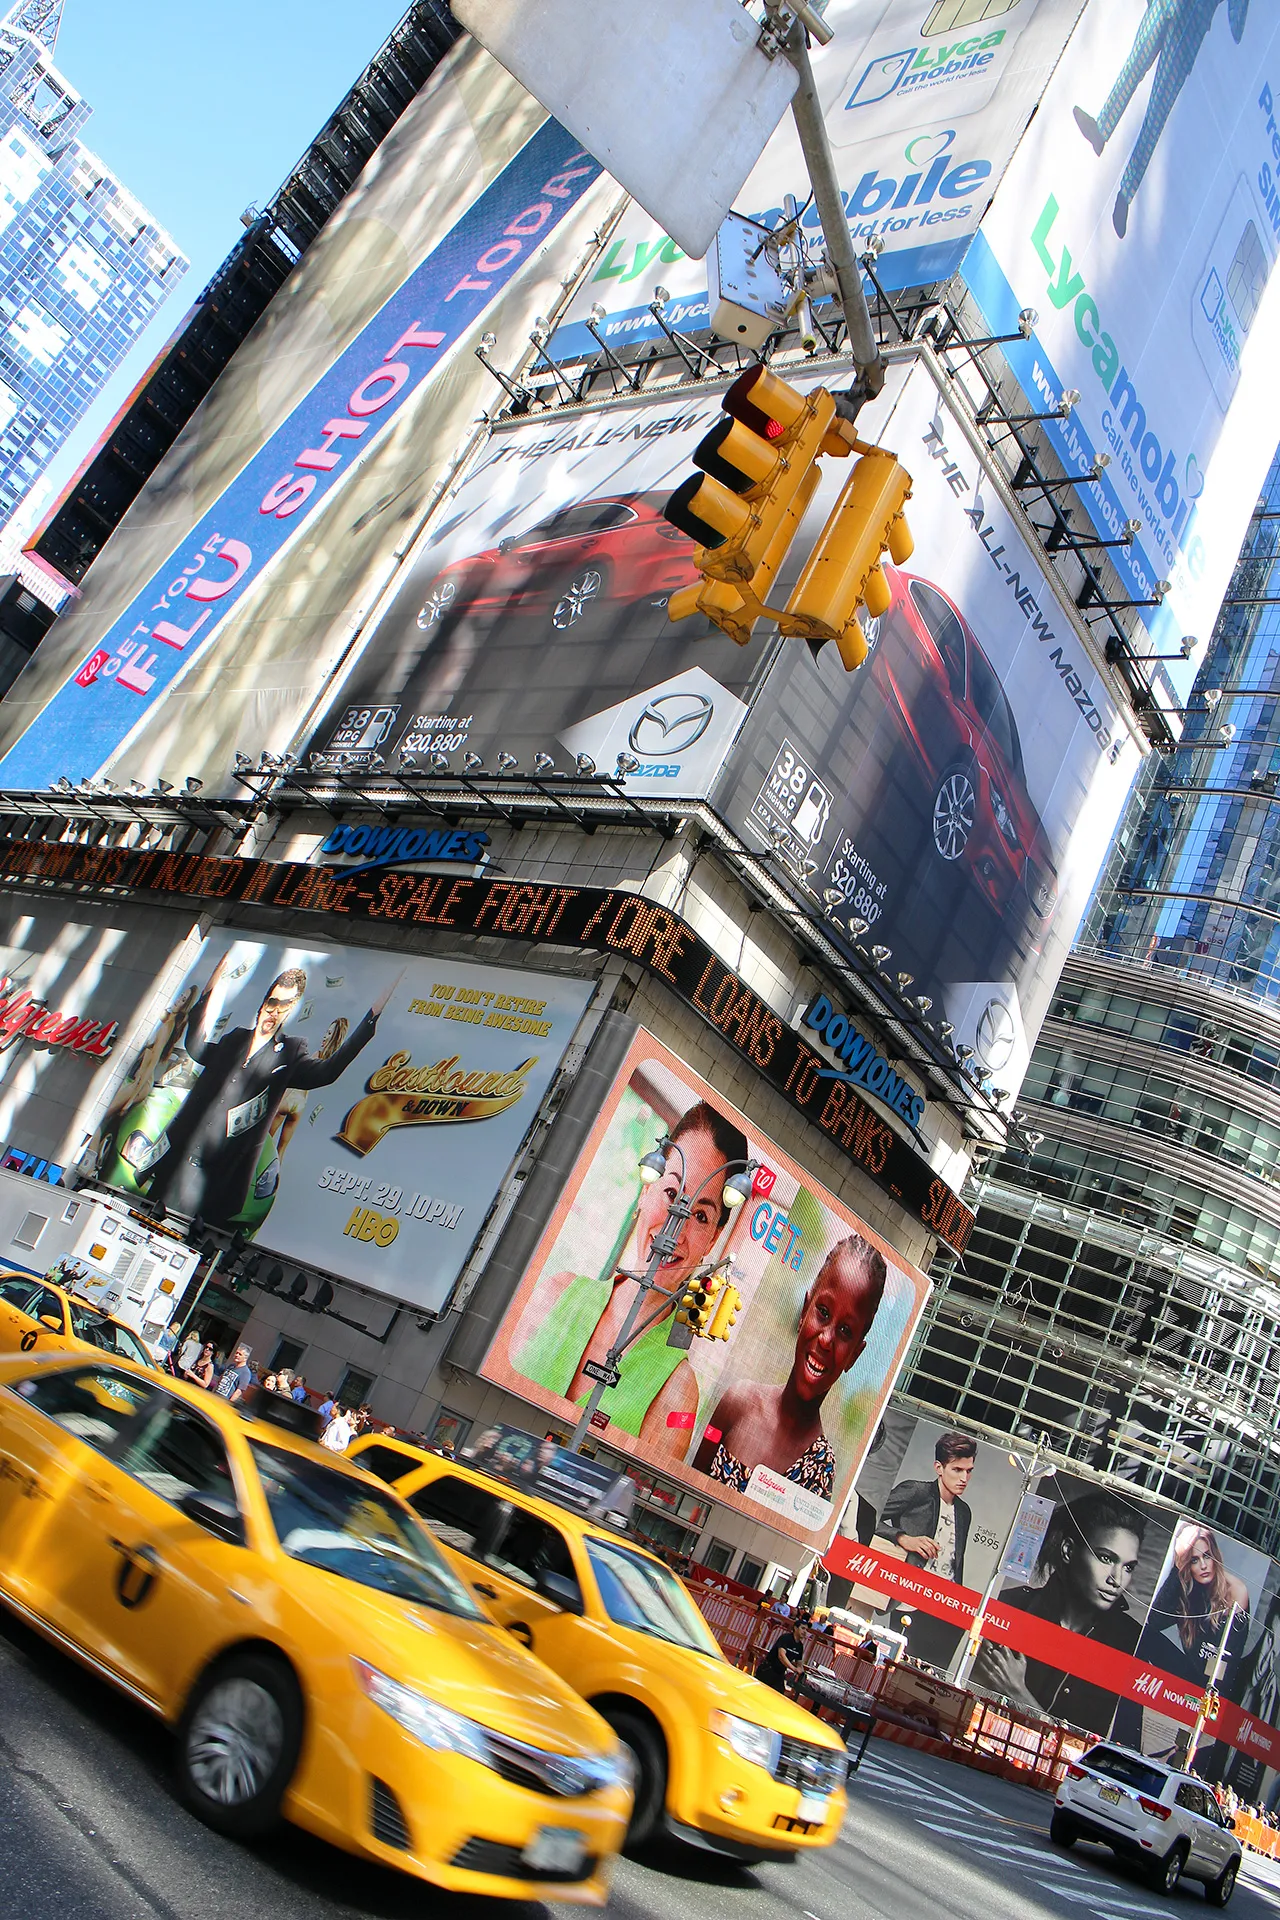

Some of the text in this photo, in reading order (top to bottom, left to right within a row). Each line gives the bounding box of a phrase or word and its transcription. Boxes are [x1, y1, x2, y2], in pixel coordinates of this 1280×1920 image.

[900, 52, 994, 87] mobile
[910, 29, 1007, 70] Lyca
[445, 151, 594, 302] TODA
[880, 214, 920, 234] for
[918, 204, 973, 228] less
[259, 320, 447, 519] SHOT
[1101, 409, 1124, 454] Call
[1121, 450, 1138, 493] the
[1136, 486, 1166, 547] world
[922, 421, 970, 499] THE
[964, 508, 1056, 642] ALL-NEW
[102, 532, 226, 677] GET YOUR
[115, 538, 252, 696] FLU
[333, 729, 361, 742] MPG
[341, 709, 372, 729] 38
[413, 714, 474, 731] Starting at
[769, 773, 797, 811] MPG
[777, 750, 807, 794] 38
[765, 788, 792, 820] HIGHWAY
[842, 838, 889, 900] Starting at
[0, 980, 120, 1055] lgreens
[408, 998, 553, 1038] FROM BEING AWESOME
[429, 983, 548, 1017] YOU DON'T RETIRE
[473, 883, 580, 936] FIGHT
[692, 954, 783, 1068] LOANS
[784, 1041, 822, 1105] TO
[818, 1079, 894, 1175] BANKS
[368, 1049, 539, 1097] Eastbound
[317, 1165, 373, 1202] SEPT.
[404, 1192, 465, 1231] 10PM
[343, 1205, 400, 1248] HBO
[750, 1202, 803, 1265] GET
[588, 1365, 615, 1382] ONE WAY
[972, 1532, 1000, 1550] $9.95
[976, 1524, 998, 1539] T-shirt
[845, 1552, 878, 1579] H&M
[879, 1568, 899, 1584] THE
[898, 1577, 923, 1594] WAIT
[923, 1587, 934, 1598] IS
[933, 1591, 960, 1610] OVER
[982, 1612, 1011, 1631] FALL!
[1132, 1672, 1164, 1700] H&M
[1163, 1688, 1186, 1706] NOW
